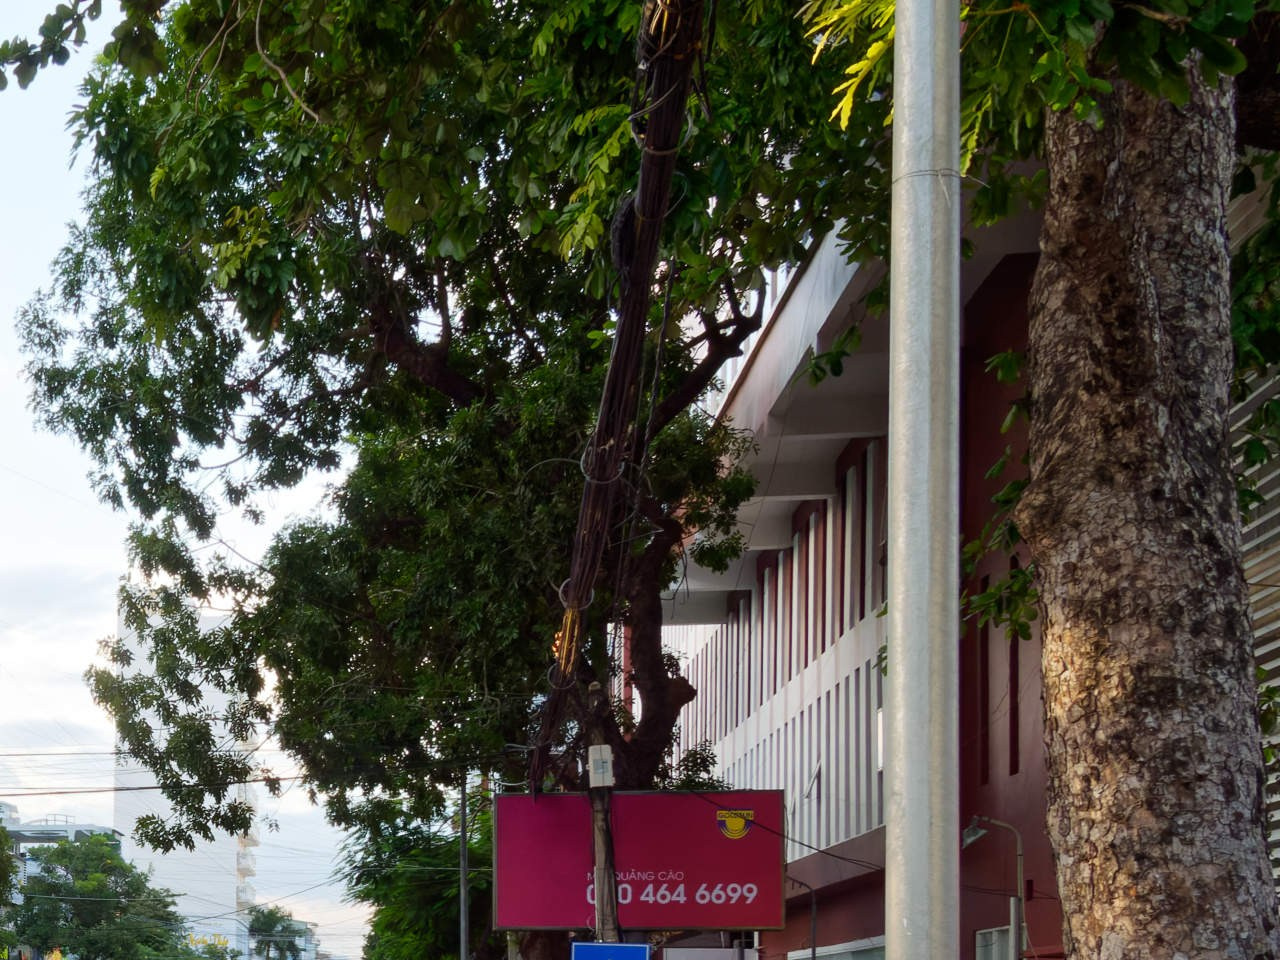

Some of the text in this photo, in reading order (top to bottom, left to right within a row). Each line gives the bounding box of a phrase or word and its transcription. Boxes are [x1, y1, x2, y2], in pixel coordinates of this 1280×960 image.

[586, 883, 758, 905] 00 464 6699
